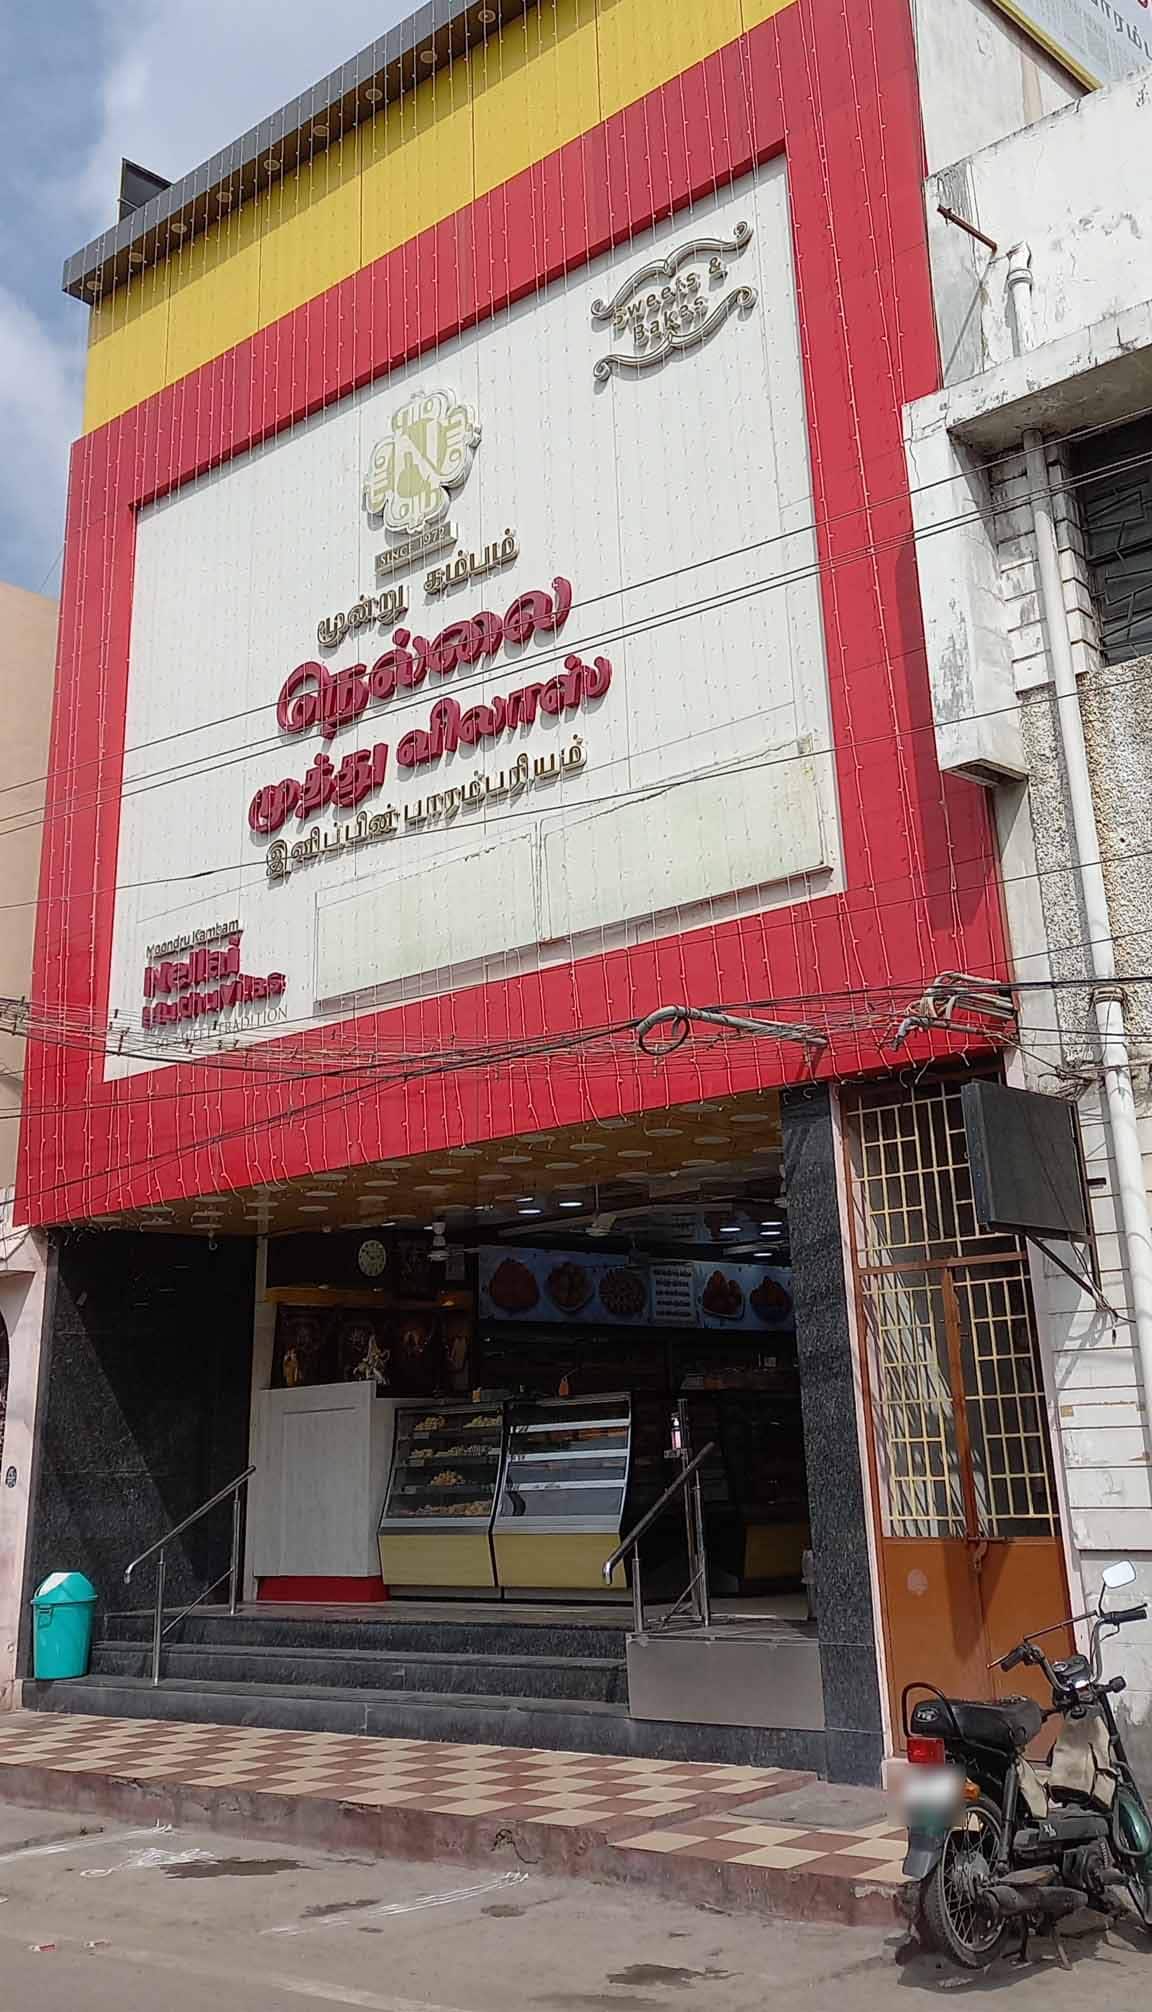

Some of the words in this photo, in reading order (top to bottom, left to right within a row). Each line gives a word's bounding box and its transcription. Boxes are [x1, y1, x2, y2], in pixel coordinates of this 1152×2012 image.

[613, 272, 699, 326] Sweets
[708, 257, 724, 277] &
[633, 296, 704, 343] Bakes
[317, 584, 408, 648] மூன்று
[423, 527, 519, 594] கம்பம்
[380, 541, 415, 567] SINCE
[276, 576, 573, 740] நெல்லை
[248, 742, 389, 833] முத்து
[396, 655, 613, 768] விலாஸ்
[266, 804, 400, 877] இனிப்பின்
[403, 734, 588, 824] பாரம்பரியம்
[145, 934, 191, 960] Moondru
[192, 919, 240, 944] Kambam
